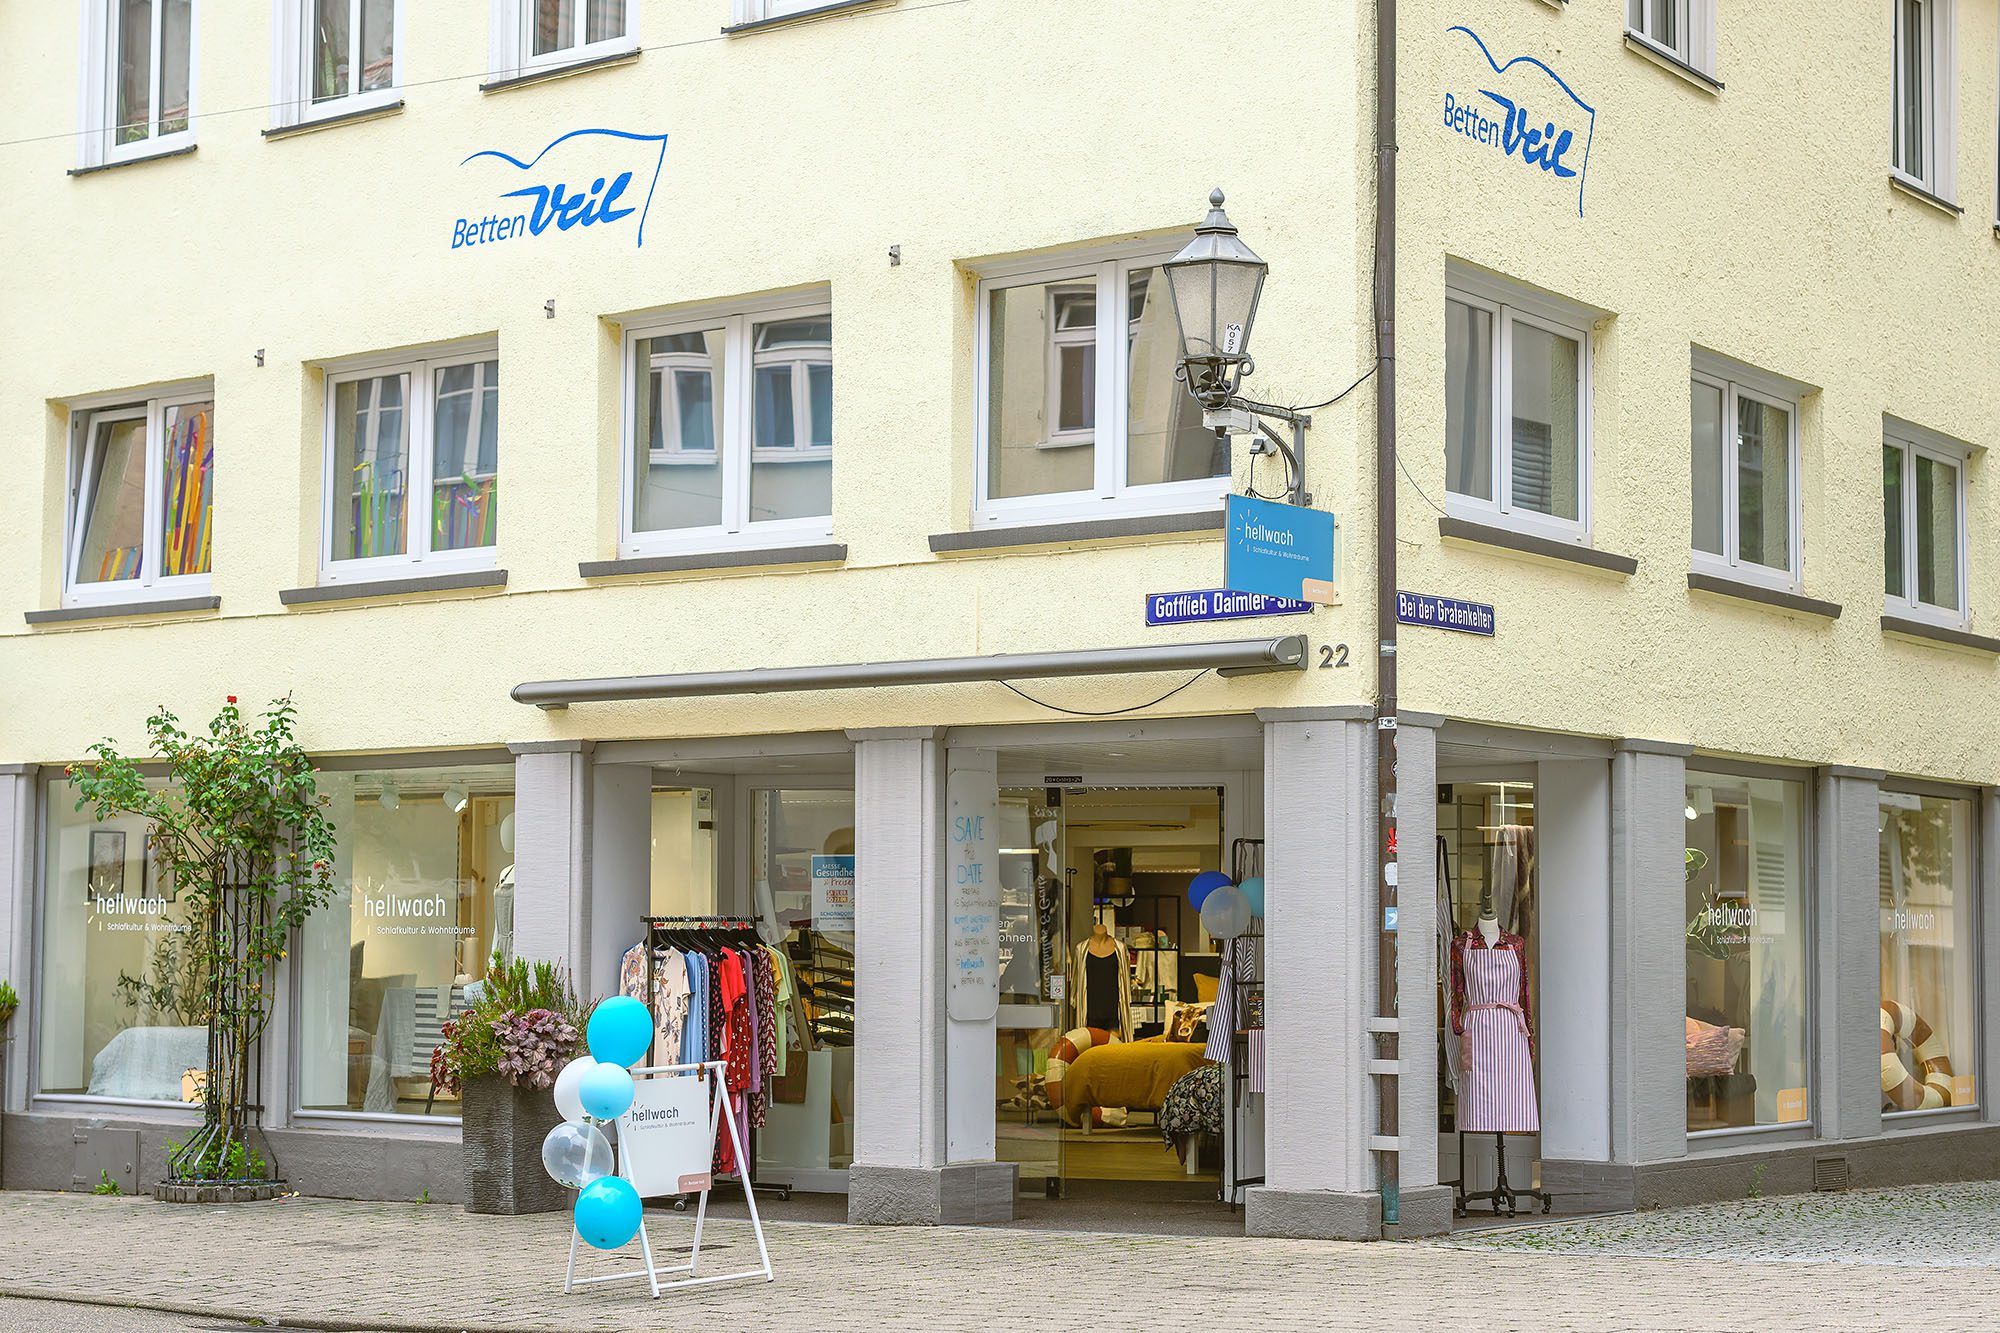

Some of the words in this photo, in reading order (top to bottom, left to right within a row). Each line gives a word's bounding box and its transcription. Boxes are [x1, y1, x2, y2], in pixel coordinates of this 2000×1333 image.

[1443, 92, 1500, 148] Betten
[1477, 88, 1577, 178] Veil
[451, 213, 526, 250] Betten
[499, 171, 637, 237] Veil
[1245, 522, 1294, 547] hellwach
[1154, 593, 1208, 619] Gottlieb
[1399, 594, 1417, 618] Bei
[1418, 597, 1435, 621] der
[1319, 643, 1350, 669] 22
[953, 815, 985, 842] SAVE
[957, 863, 984, 885] DATE
[96, 892, 167, 915] hellwach
[363, 893, 447, 918] hellwach
[1707, 902, 1759, 926] hellwach
[106, 922, 143, 931] Schlafkultur
[144, 923, 150, 931] &
[376, 925, 419, 935] Schlafkultur
[420, 925, 427, 935] &
[428, 926, 476, 935] Wohnträume
[1894, 907, 1935, 930] hellwach
[998, 933, 1036, 943] ohnen.
[632, 1107, 679, 1122] hellwach
